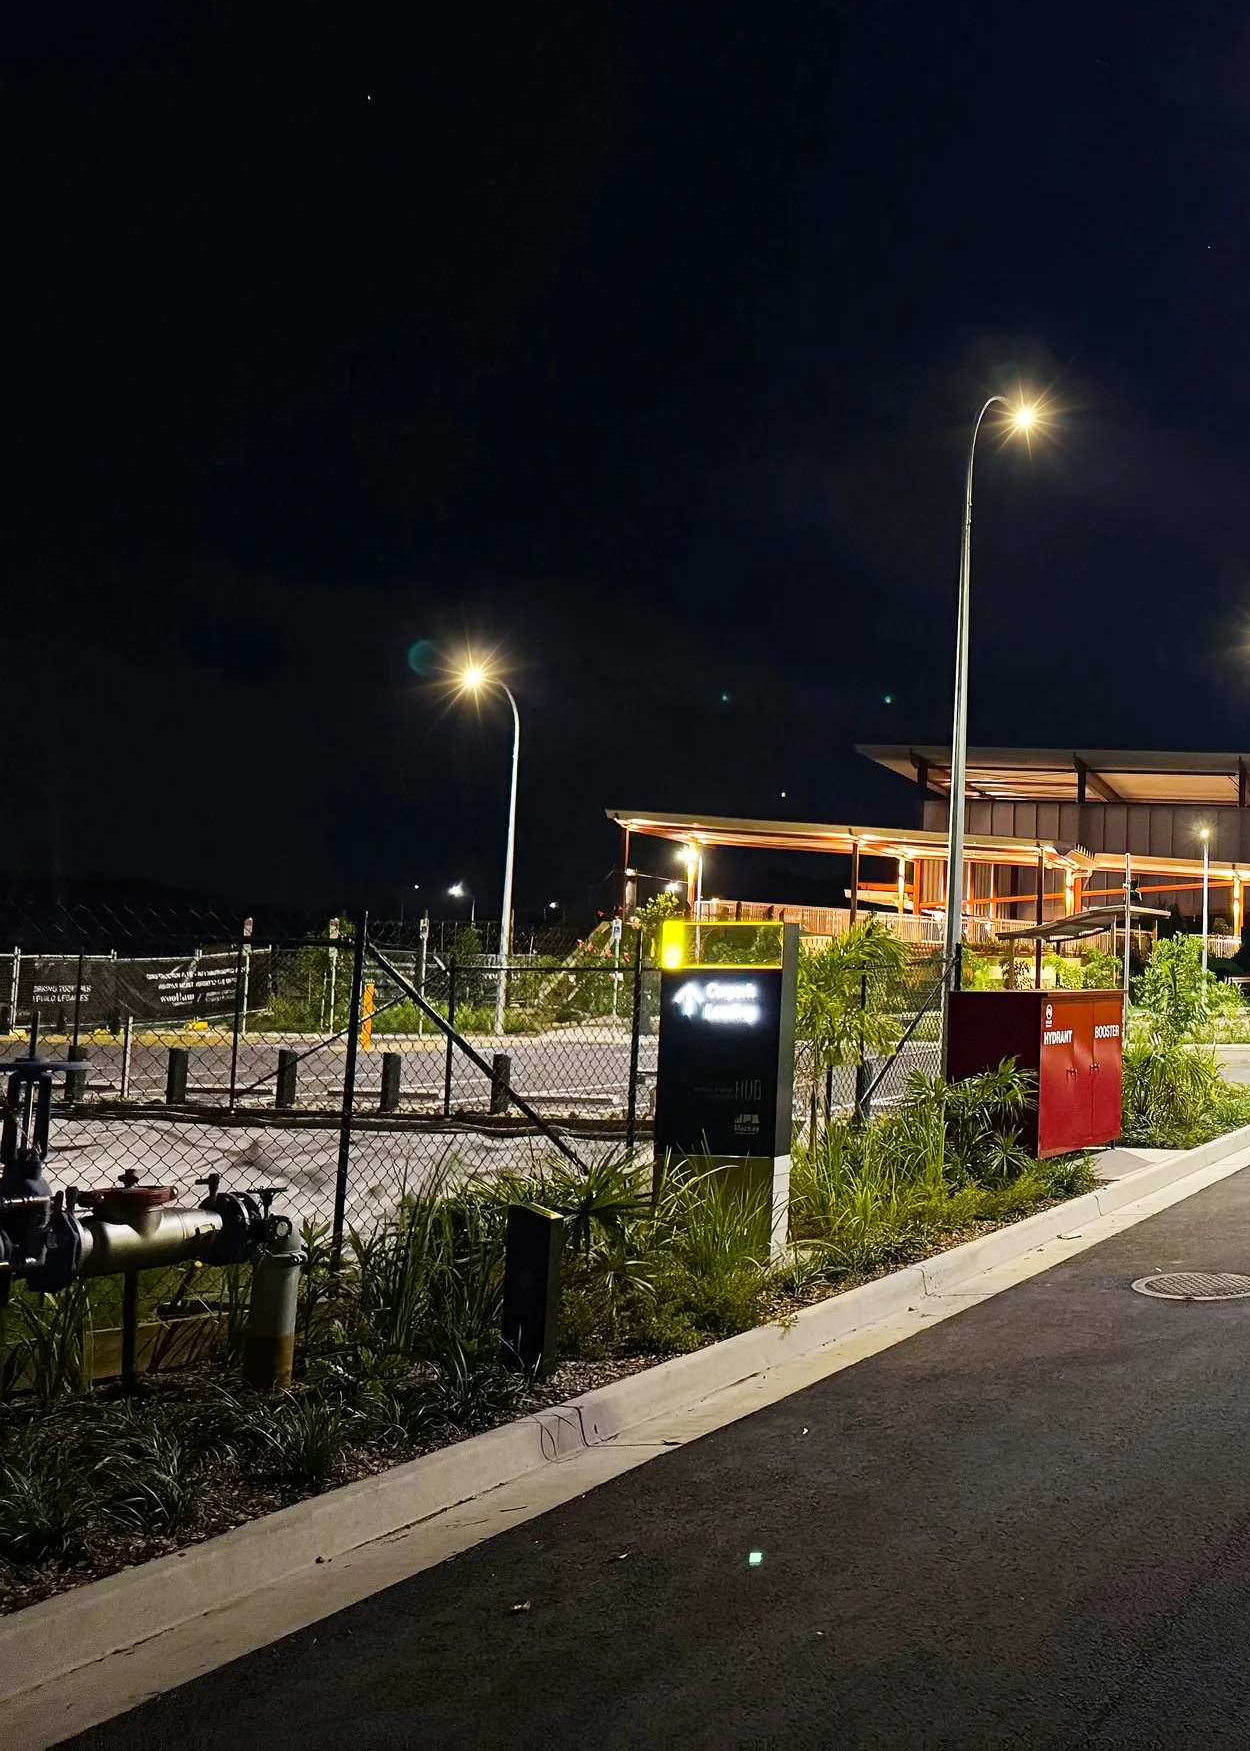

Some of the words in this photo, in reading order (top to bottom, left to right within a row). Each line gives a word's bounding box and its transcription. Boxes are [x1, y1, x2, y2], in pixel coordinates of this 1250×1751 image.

[1044, 1030, 1073, 1045] HYDRANT
[1095, 1025, 1120, 1038] BOOSTER
[735, 1079, 762, 1100] HUB
